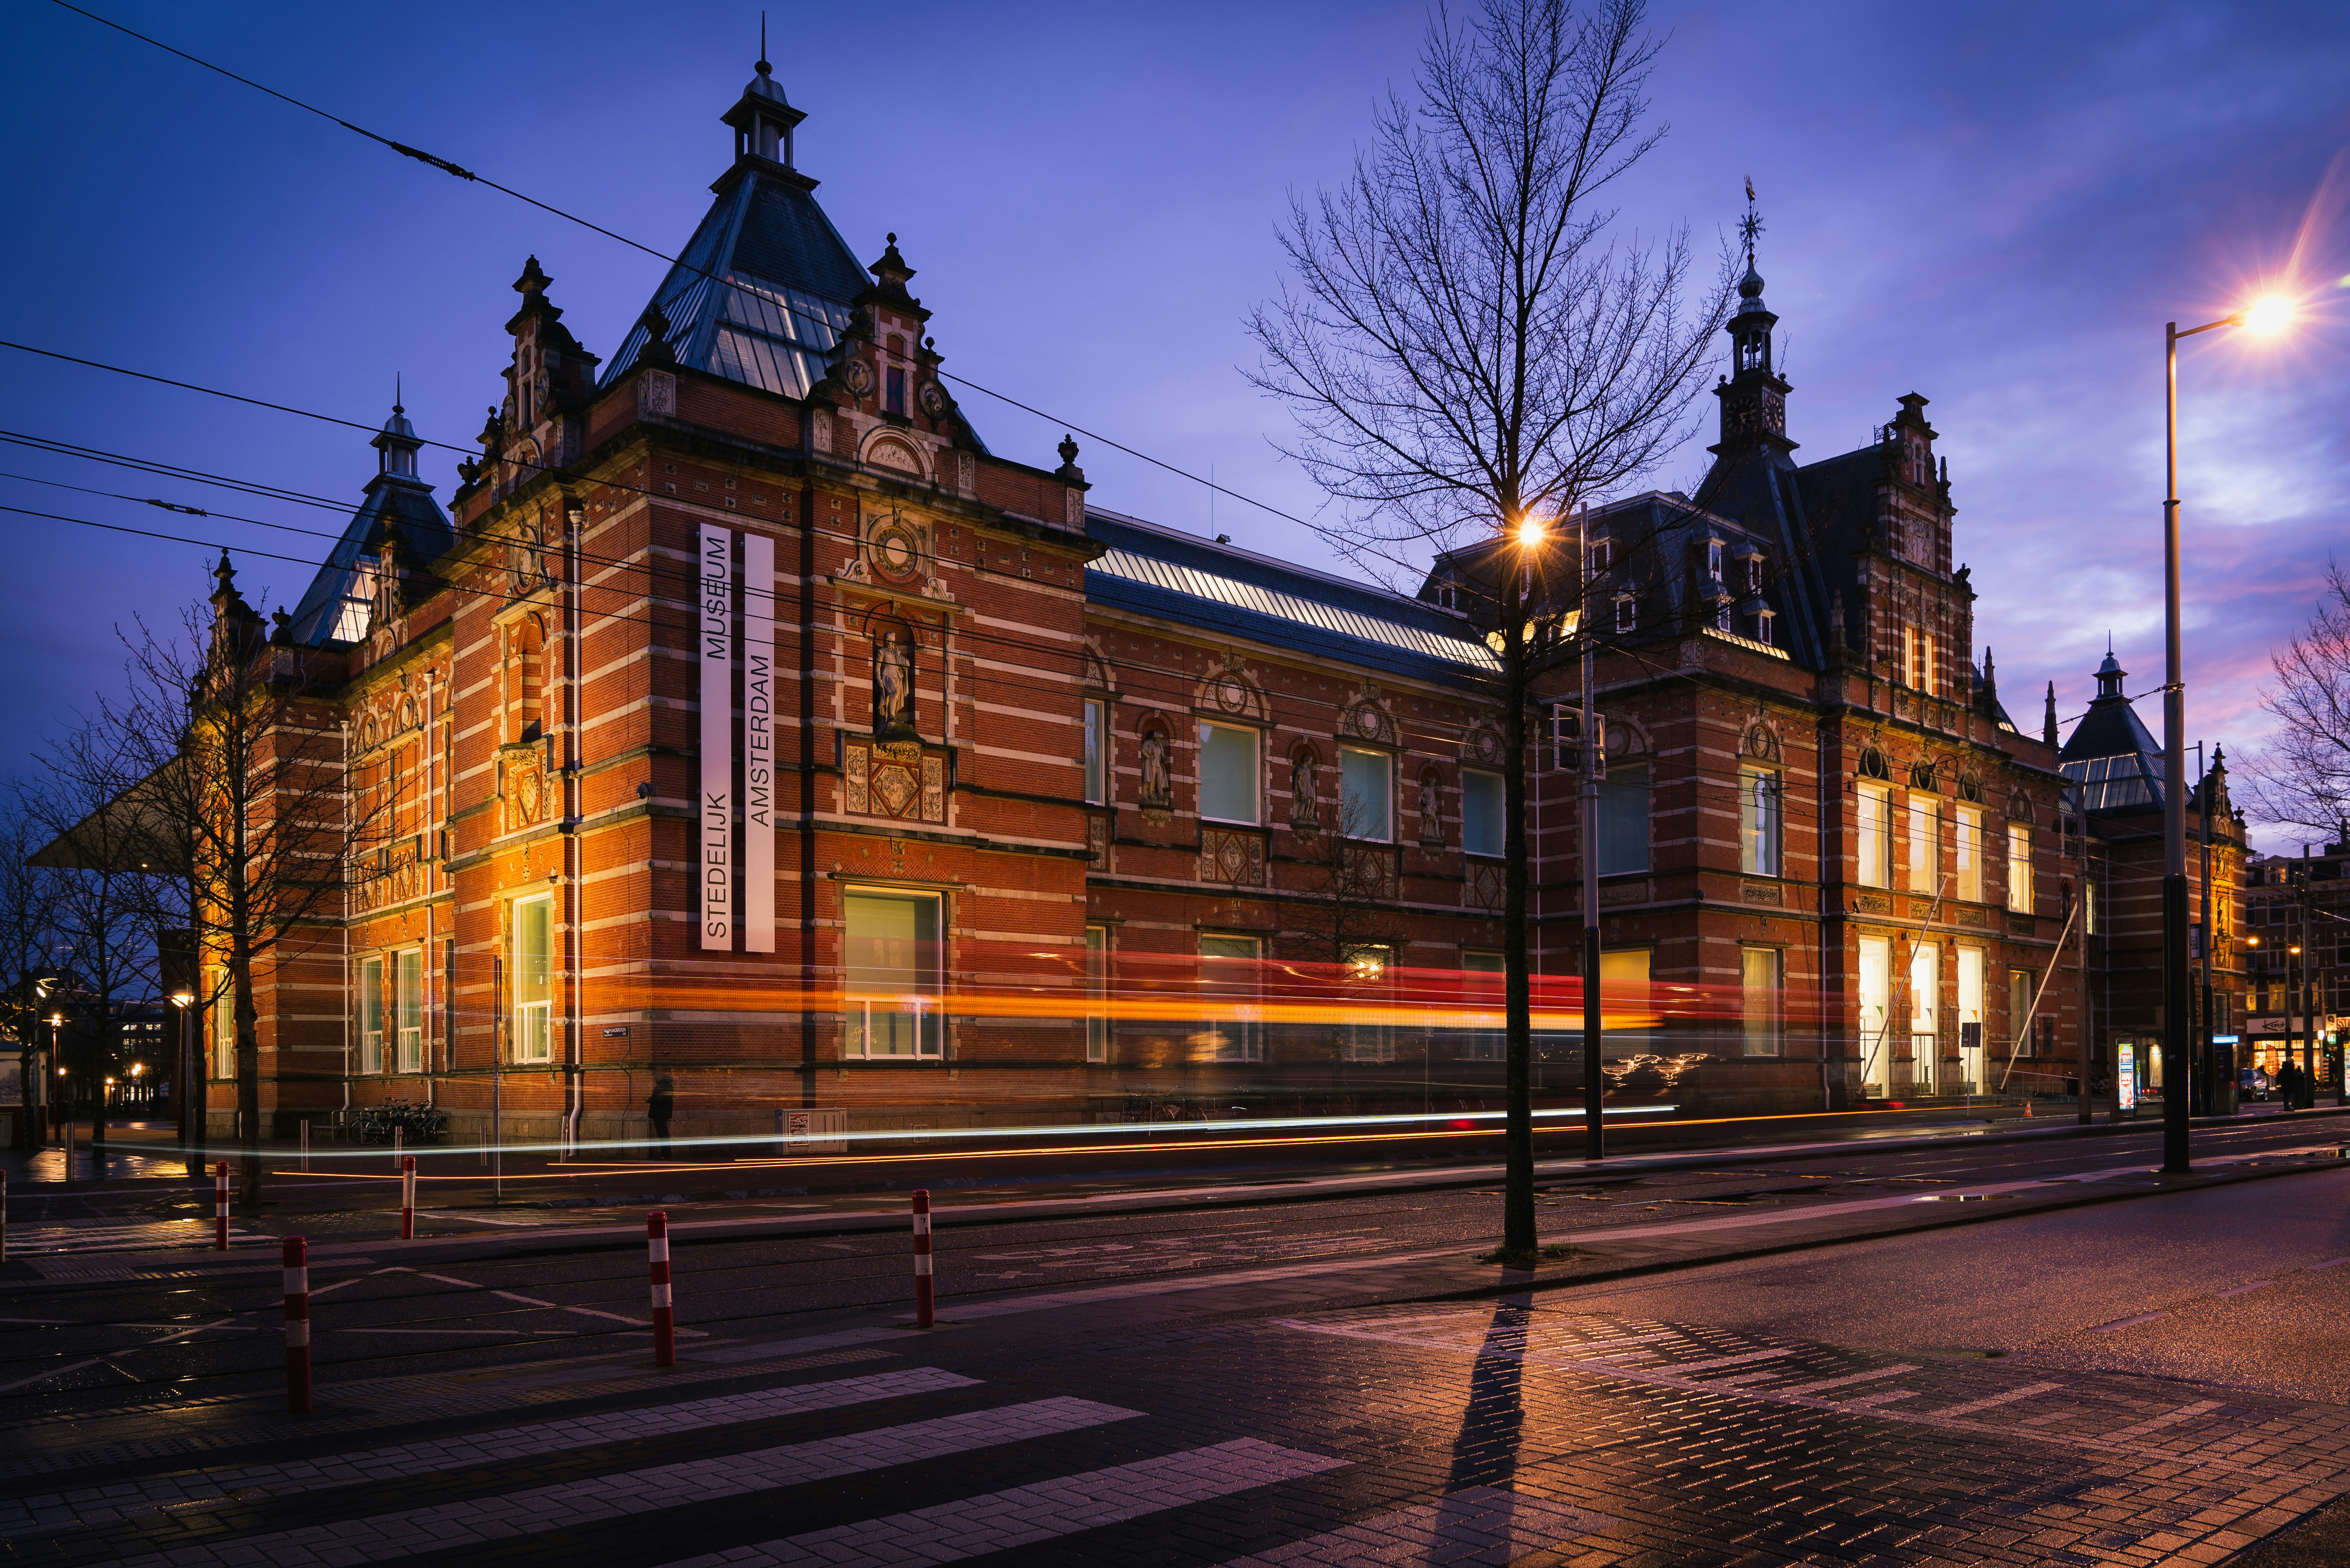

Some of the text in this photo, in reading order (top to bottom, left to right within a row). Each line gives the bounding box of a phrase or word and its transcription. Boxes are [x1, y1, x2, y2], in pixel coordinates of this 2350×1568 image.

[706, 536, 726, 938] STEDELIJK MUSEUM
[750, 655, 769, 828] AMSTERDAM
